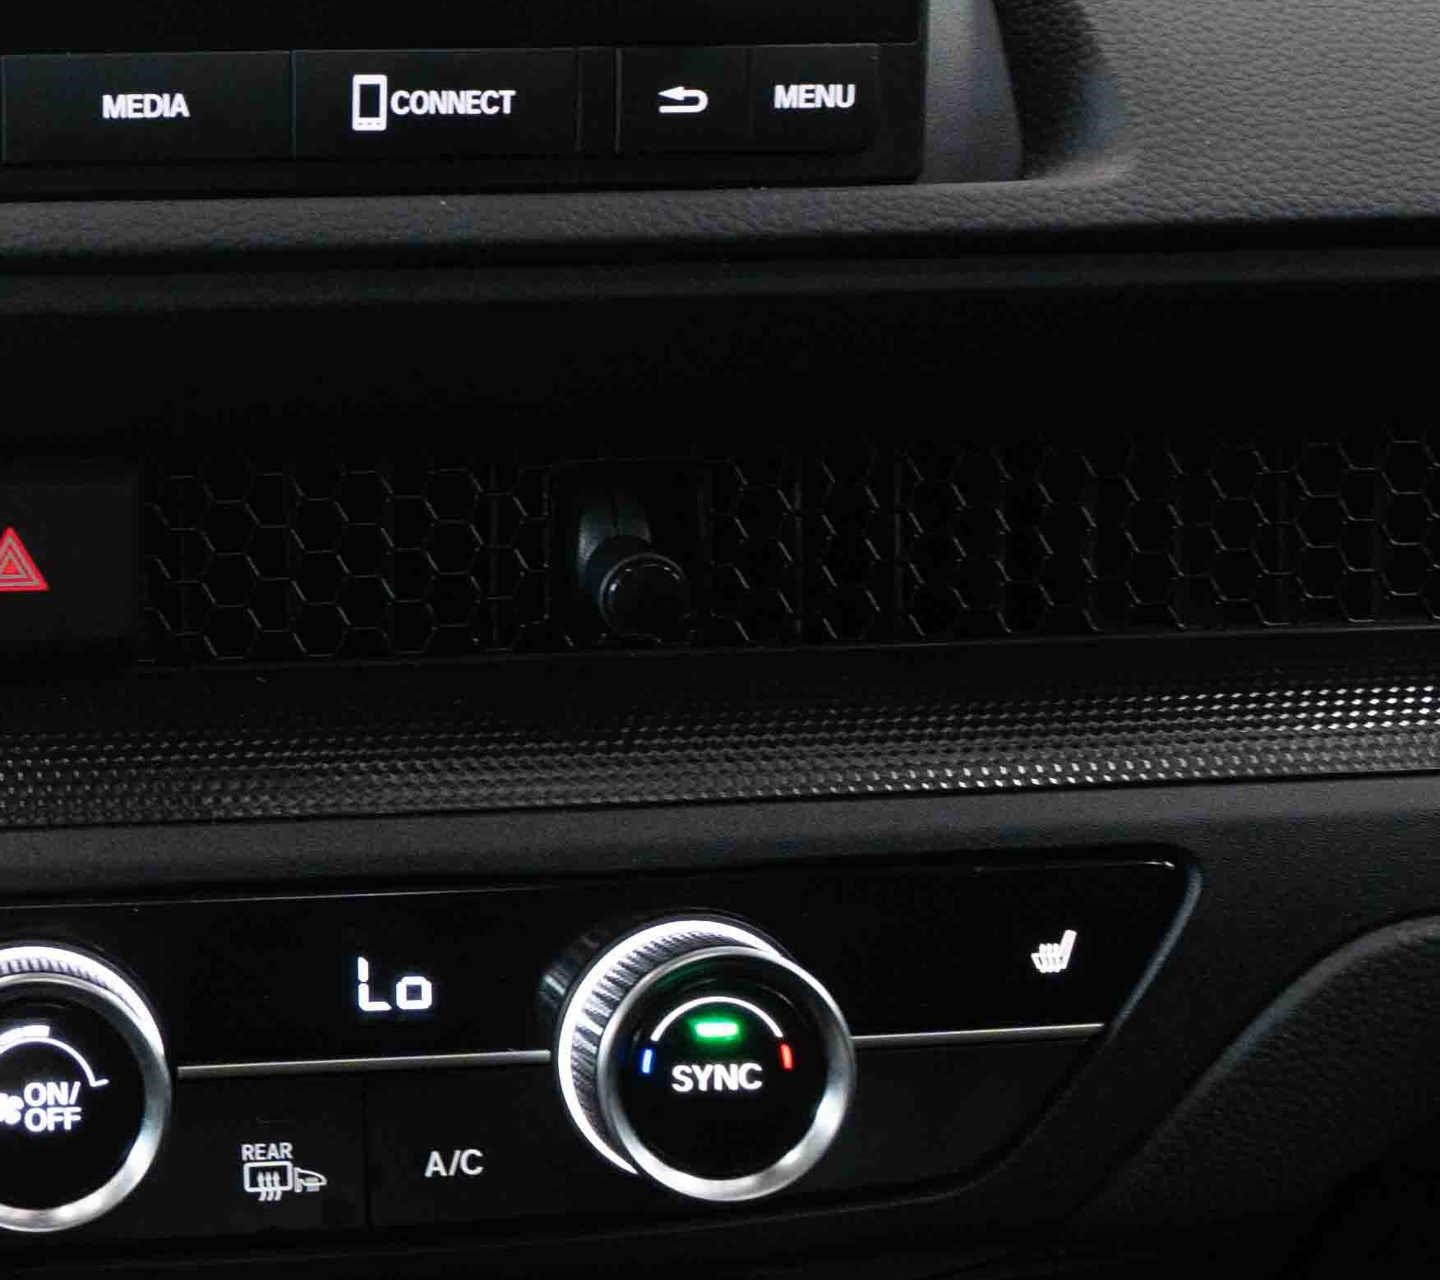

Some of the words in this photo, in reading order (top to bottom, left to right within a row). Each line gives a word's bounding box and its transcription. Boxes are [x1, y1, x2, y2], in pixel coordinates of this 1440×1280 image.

[102, 92, 190, 119] MEDIA
[390, 89, 517, 116] CONNECT
[773, 83, 856, 109] MENU
[671, 1062, 763, 1093] SYNC
[23, 1106, 82, 1132] OFF
[241, 1142, 295, 1162] REAR
[424, 1148, 484, 1178] A/C
